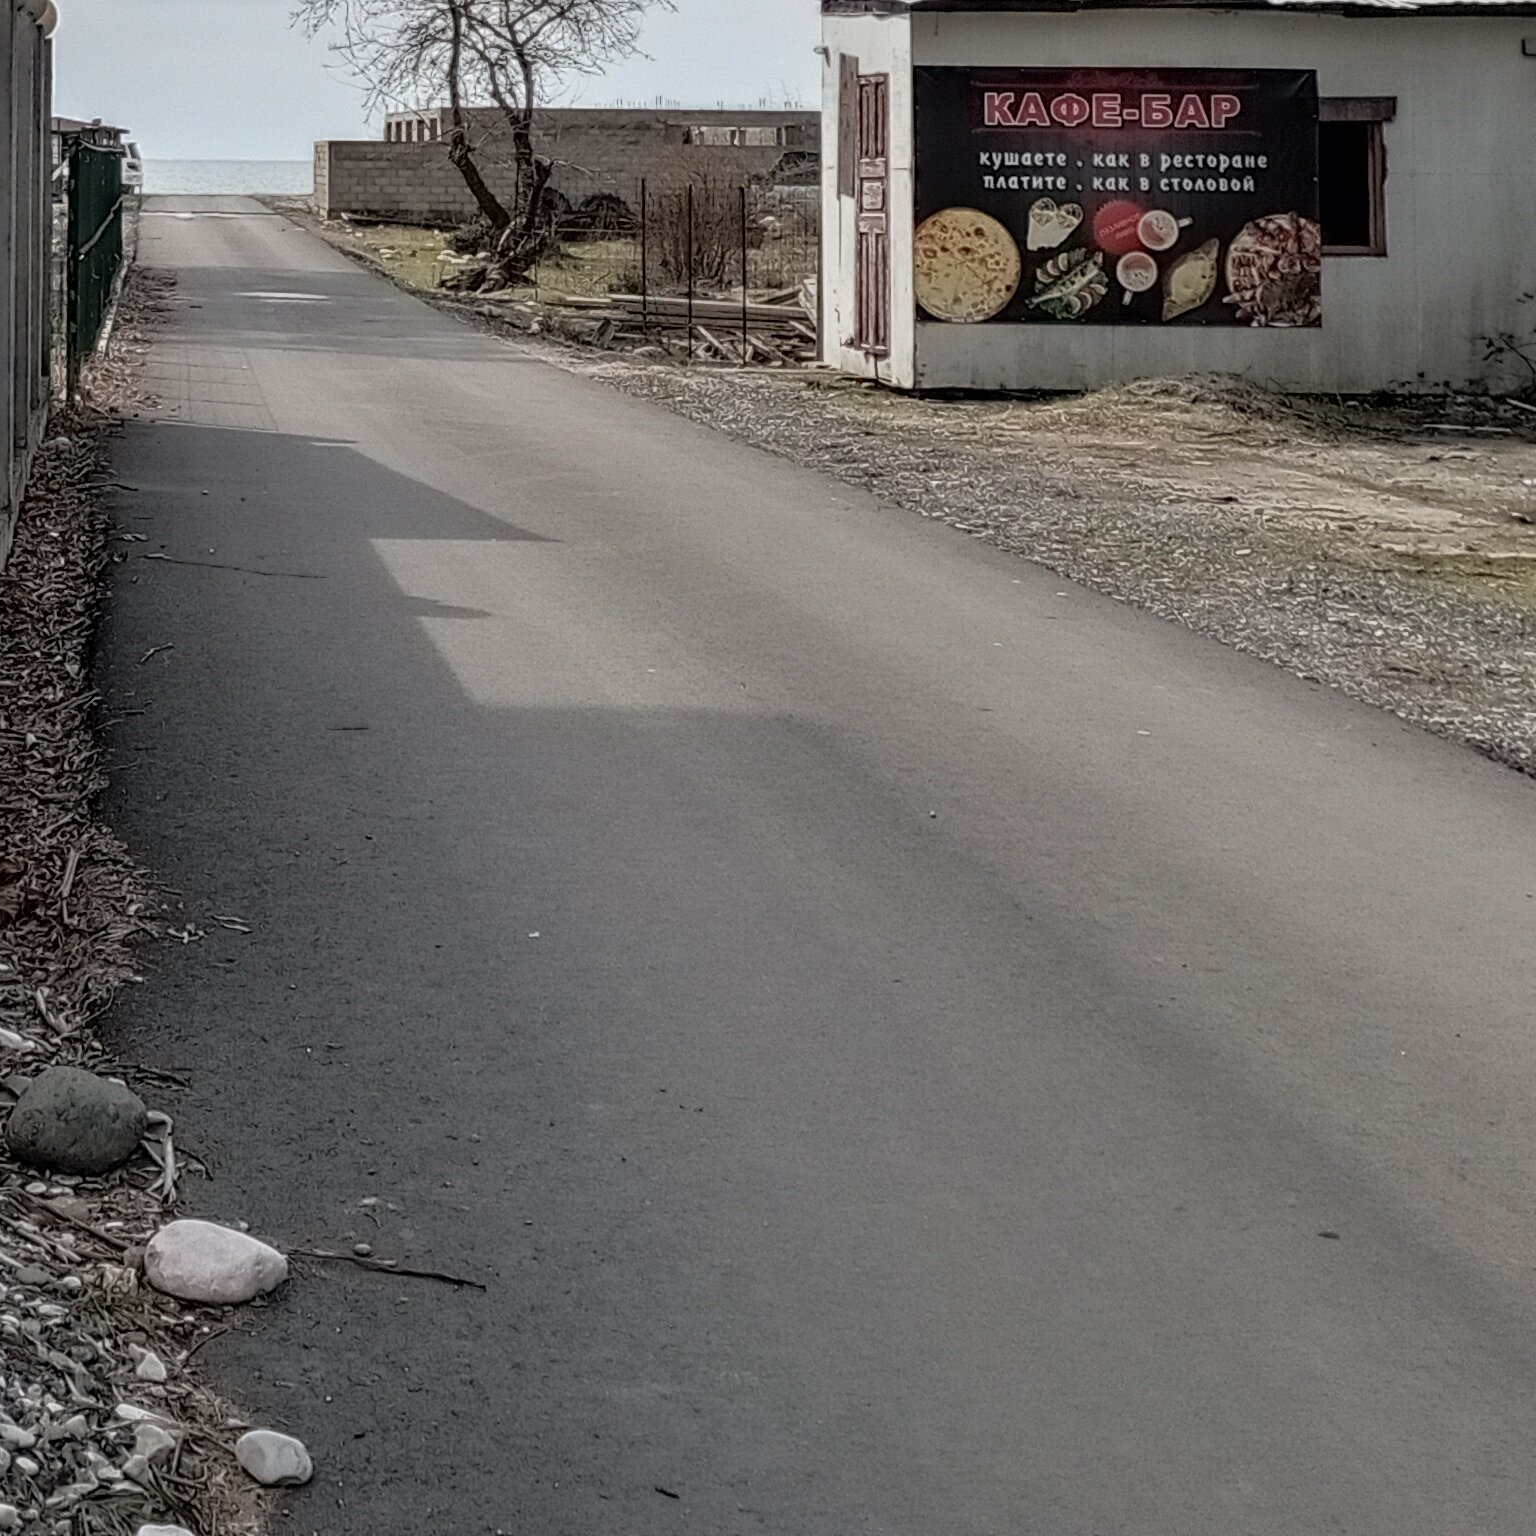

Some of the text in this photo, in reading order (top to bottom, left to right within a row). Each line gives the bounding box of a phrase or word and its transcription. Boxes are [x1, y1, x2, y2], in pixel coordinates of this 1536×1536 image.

[983, 92, 1241, 128] КАФЕ-БАР
[979, 151, 1067, 170] кушаете
[1093, 153, 1130, 168] как
[1140, 154, 1150, 168] в
[1160, 154, 1268, 173] ресторане
[983, 175, 1067, 190] платите
[1093, 176, 1130, 191] как
[1140, 176, 1150, 191] в
[1160, 175, 1255, 192] столовой
